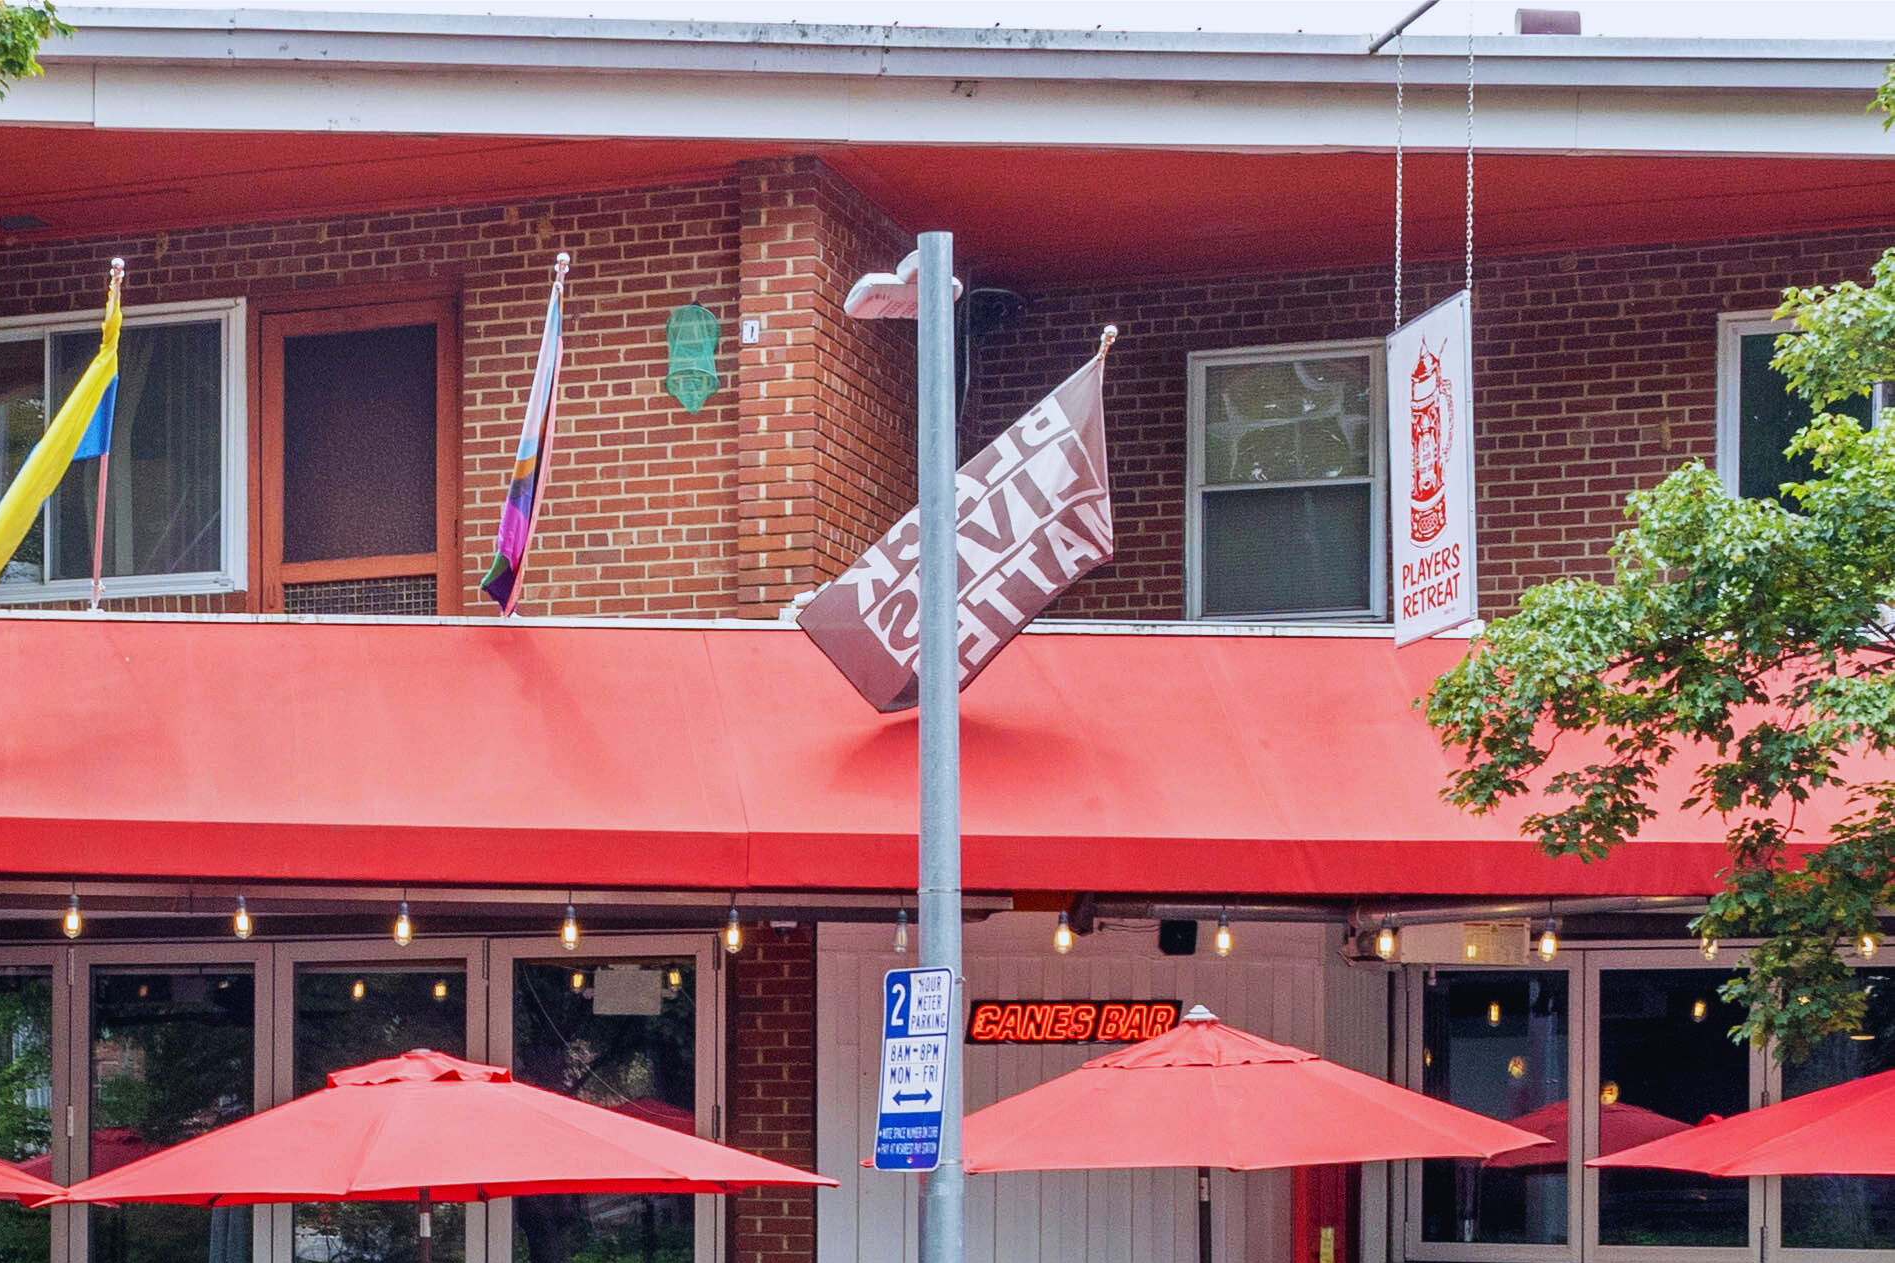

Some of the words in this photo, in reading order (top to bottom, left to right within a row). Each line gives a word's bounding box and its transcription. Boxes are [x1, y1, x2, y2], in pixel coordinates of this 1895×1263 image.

[1402, 542, 1460, 590] PLAYERS
[1403, 571, 1461, 620] RETREAT
[918, 975, 942, 993] HOUR
[890, 983, 906, 1027] 2
[916, 994, 942, 1013] METER
[910, 1012, 946, 1031] PARKING
[971, 1003, 1097, 1041] CANES
[1097, 1003, 1176, 1041] BAR
[889, 1066, 911, 1085] MON
[922, 1064, 939, 1084] FRI
